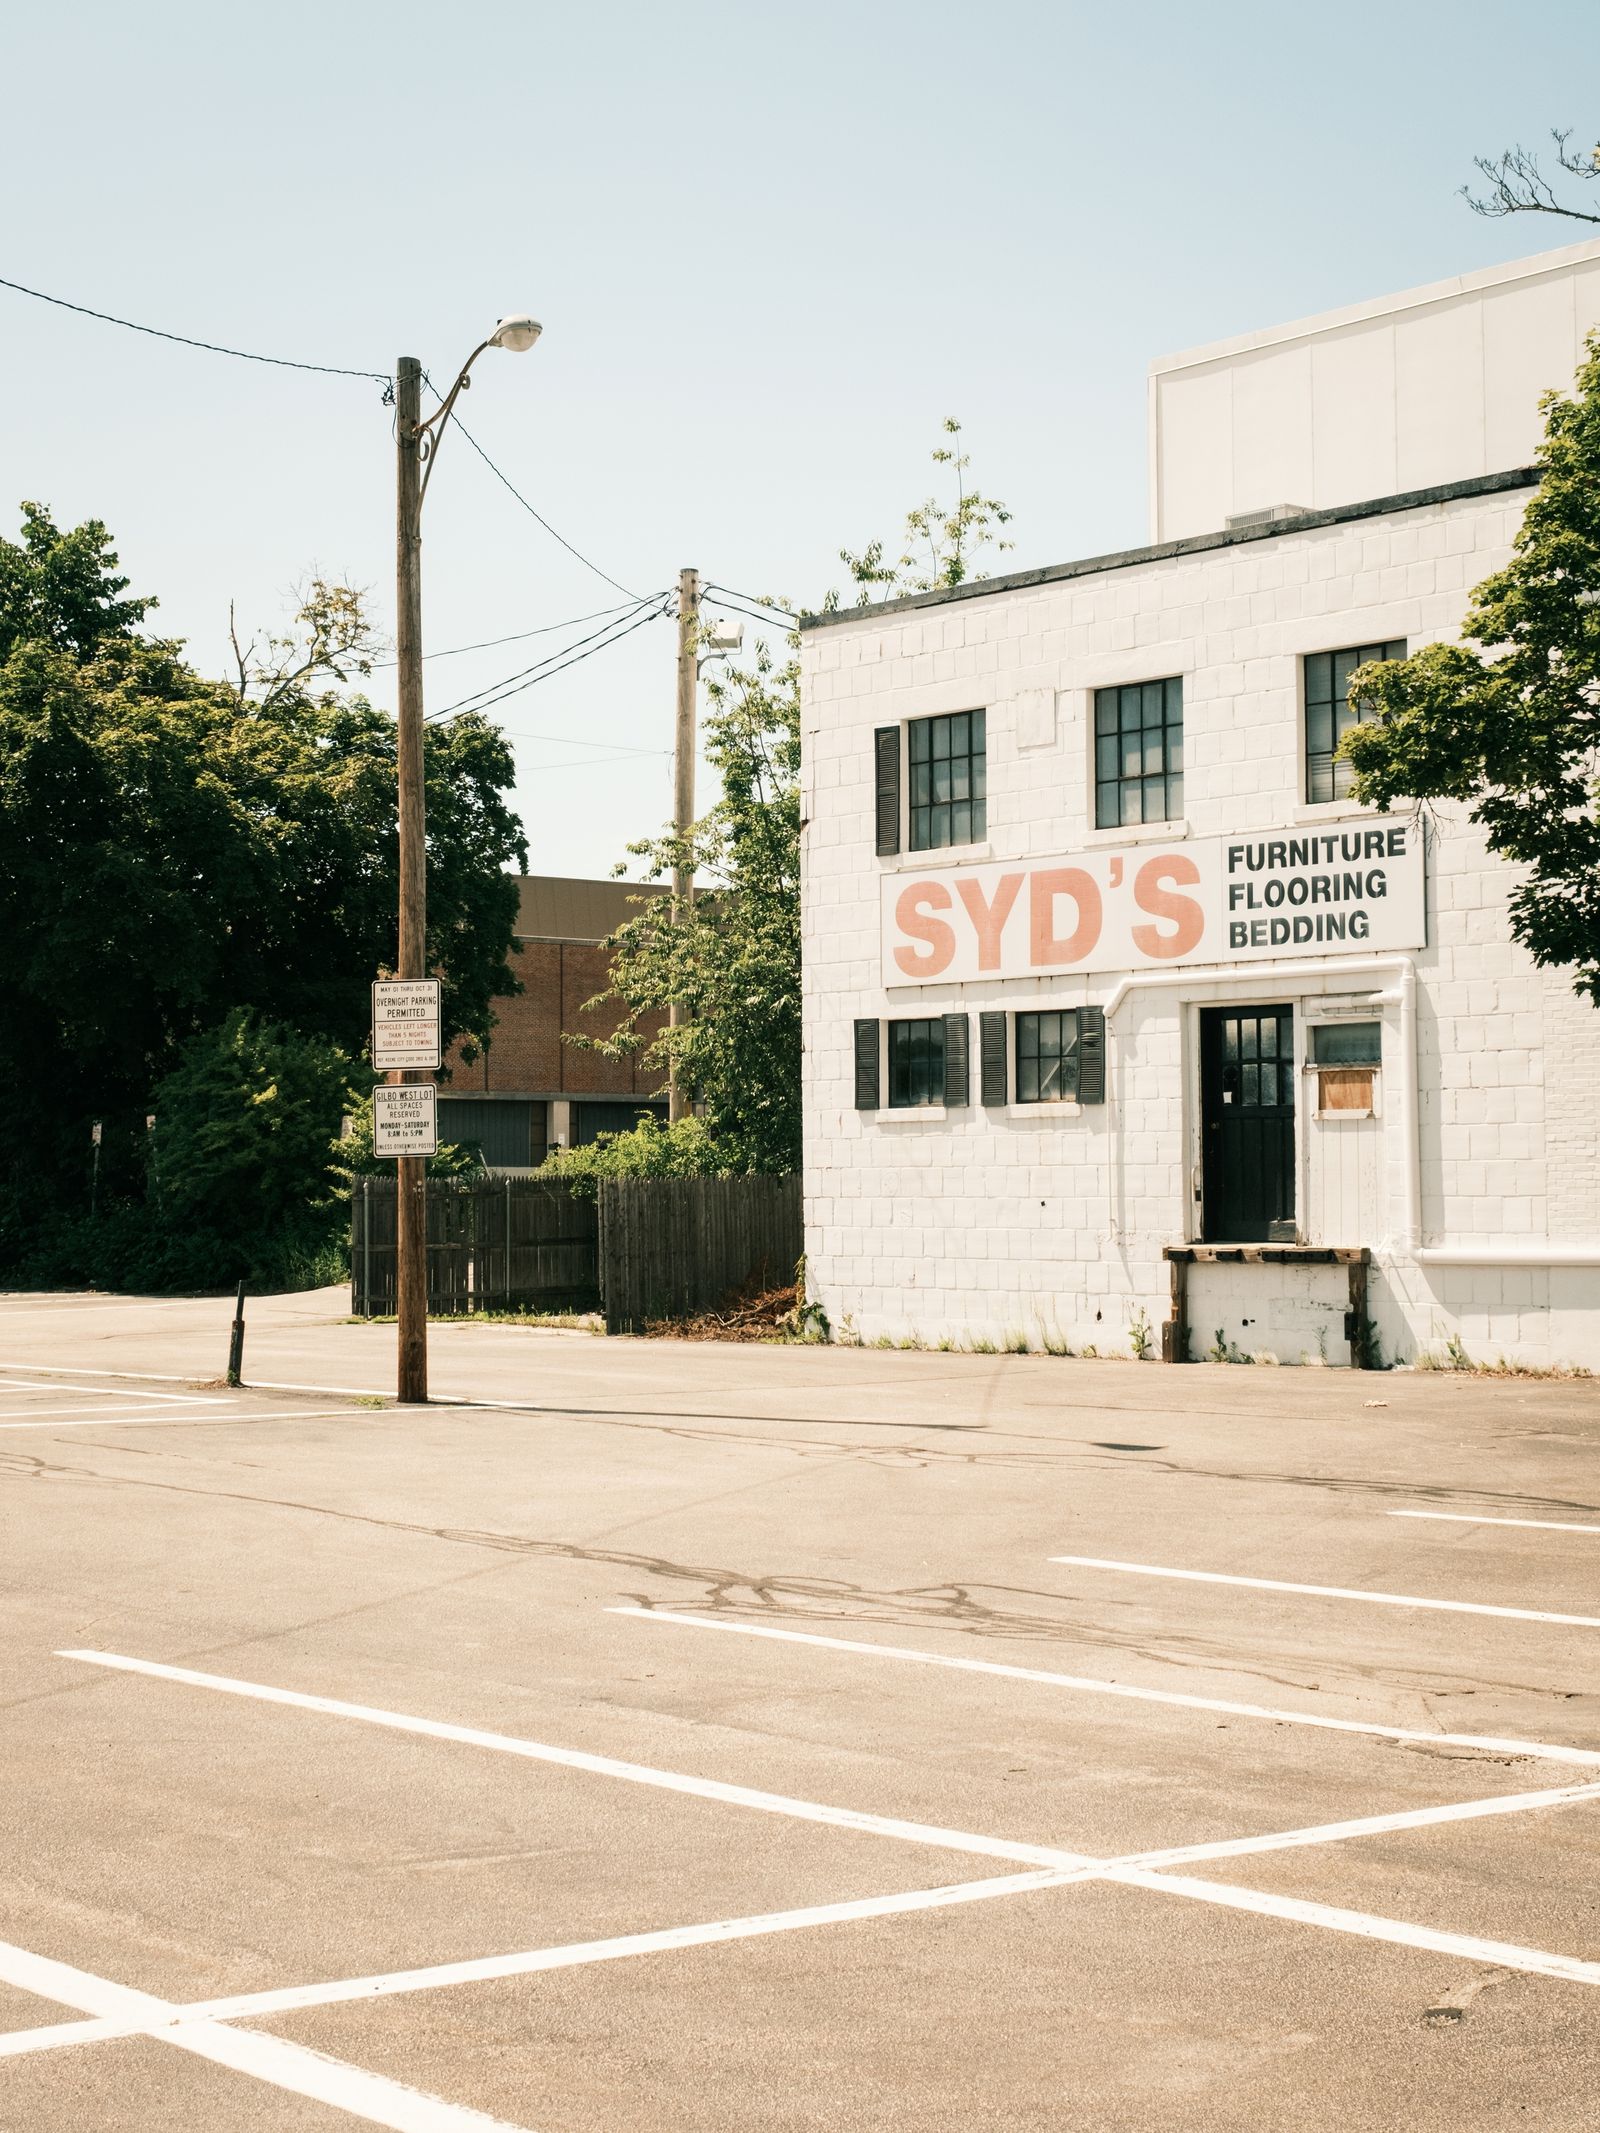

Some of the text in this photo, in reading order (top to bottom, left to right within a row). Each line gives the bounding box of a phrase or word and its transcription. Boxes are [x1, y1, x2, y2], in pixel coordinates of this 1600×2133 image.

[1228, 828, 1406, 873] FURNITURE
[1229, 869, 1387, 911] FLOORING
[893, 854, 1205, 978] SYD'S
[1229, 910, 1369, 948] BEDDING
[376, 996, 436, 1007] OVERNIGHT PARKING
[387, 1008, 425, 1018] PERMITTED
[377, 1090, 432, 1101] GILBO WEST LOT
[387, 1101, 423, 1110] ALL SPACES
[389, 1110, 421, 1118] RESERVED
[380, 1121, 430, 1129] MONDAY-SATURDAY
